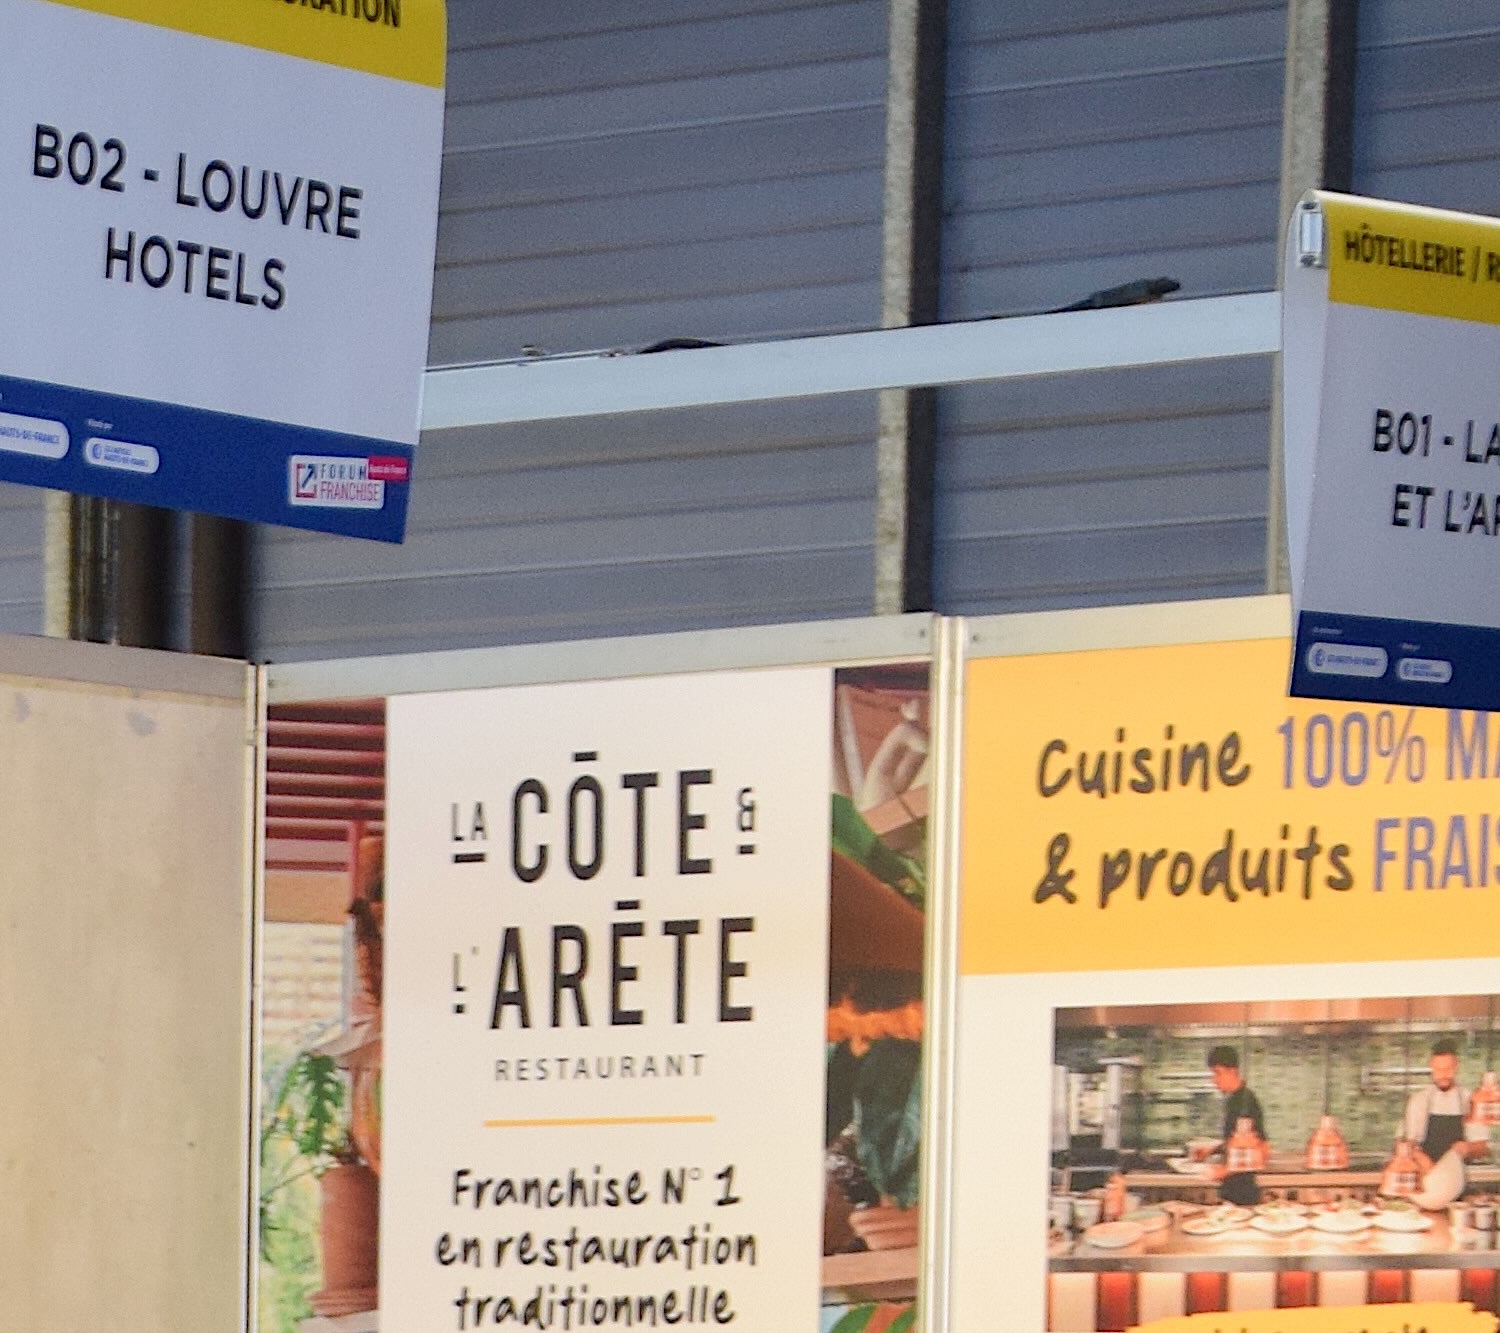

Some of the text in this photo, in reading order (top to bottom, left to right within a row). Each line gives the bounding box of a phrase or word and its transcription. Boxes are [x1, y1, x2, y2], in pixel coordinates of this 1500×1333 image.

[33, 123, 363, 240] B02 - LOUVRE
[106, 227, 287, 311] HOTELS
[1343, 223, 1466, 279] HÔTELLERIE
[1373, 408, 1434, 458] B01
[321, 464, 367, 480] FORUM
[321, 481, 380, 501] FRANCHISE
[1391, 484, 1434, 529] ET
[1038, 725, 1252, 799] Cuisine
[1276, 707, 1427, 792] 100%
[452, 802, 486, 842] LA
[735, 785, 758, 832] &
[1033, 832, 1079, 904] &
[1097, 823, 1355, 908] produits
[494, 1053, 708, 1083] RESTAURANT
[453, 1165, 742, 1210] Franchise N° 1
[437, 1223, 759, 1272] en restauration
[453, 1284, 736, 1331] traditionnelle
